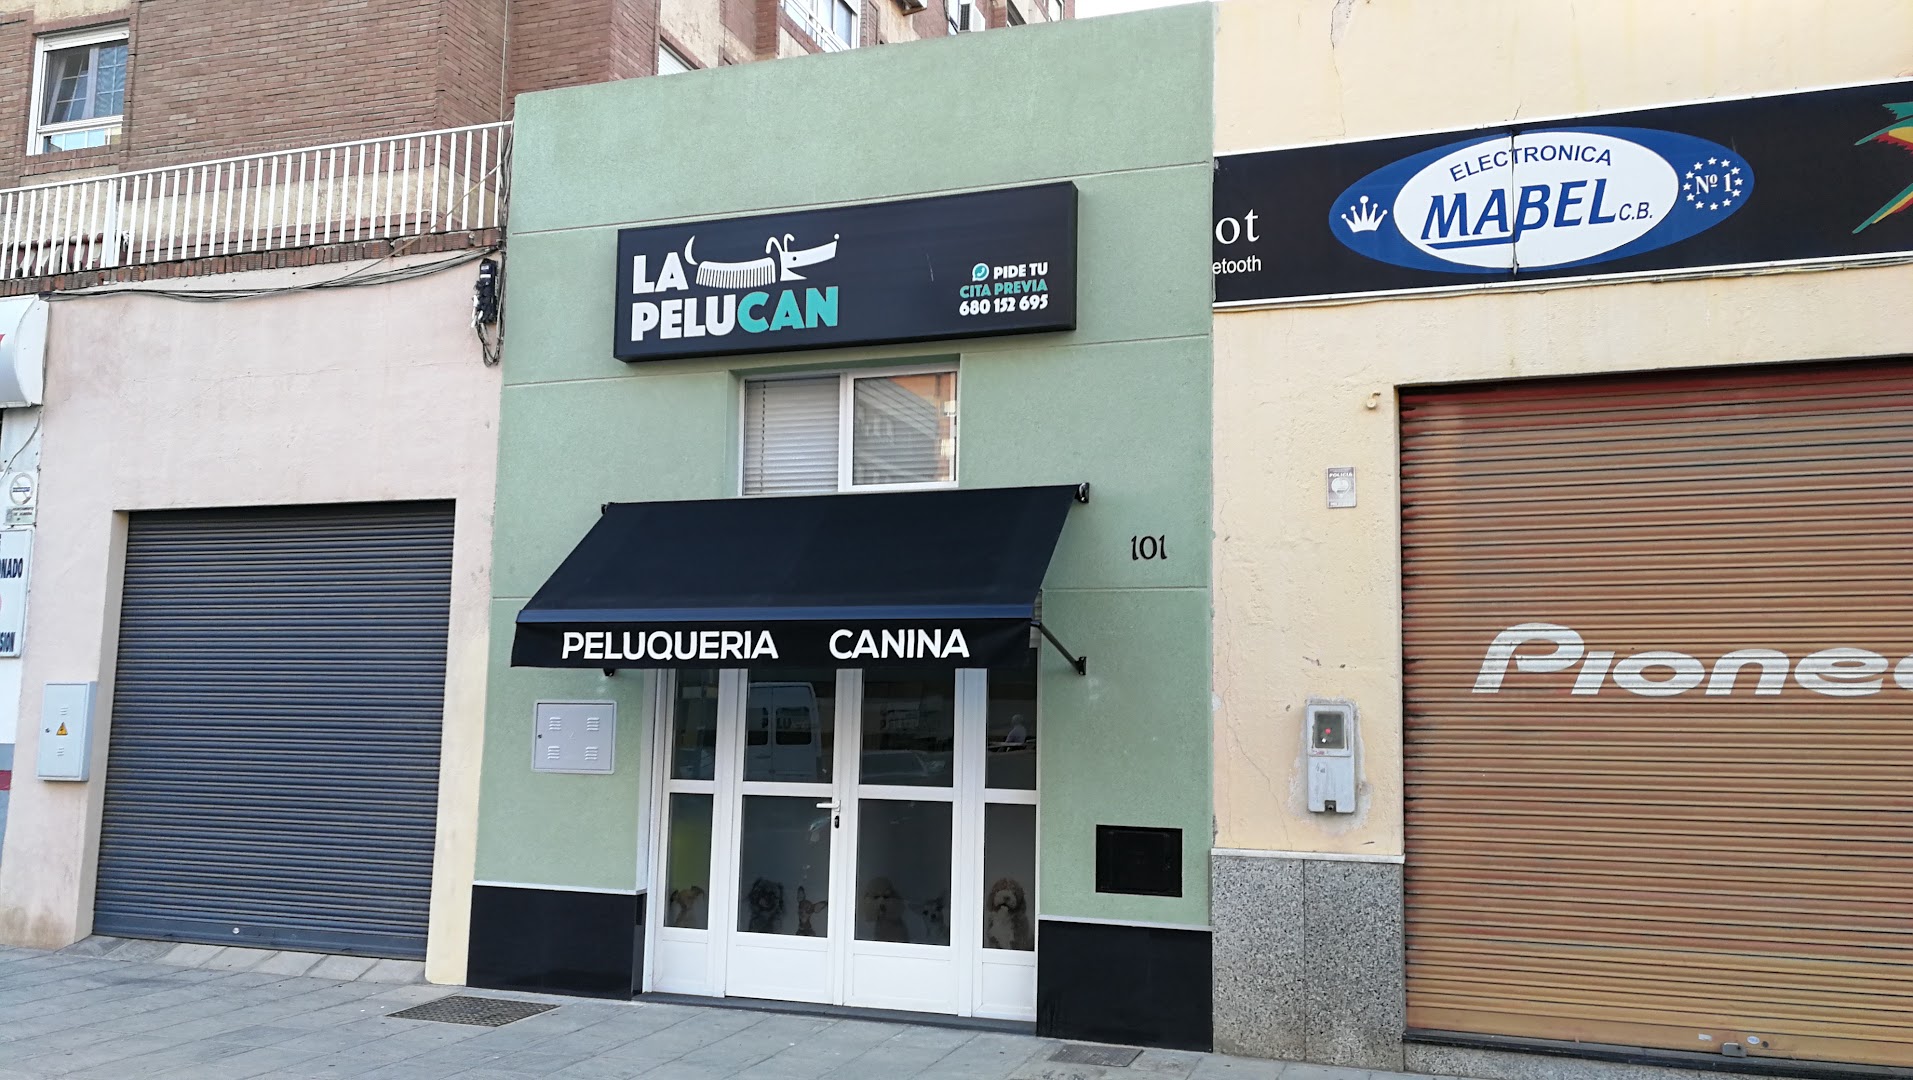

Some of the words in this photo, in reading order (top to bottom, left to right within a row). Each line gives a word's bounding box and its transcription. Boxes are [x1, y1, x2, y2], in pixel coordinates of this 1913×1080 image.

[1449, 144, 1612, 182] ELECTRONICA
[1723, 172, 1733, 192] 1
[1215, 208, 1260, 245] ot
[1420, 178, 1617, 243] MABEL
[1618, 201, 1653, 222] C.B.
[632, 251, 690, 295] LA
[993, 263, 1027, 280] PIDE
[1029, 261, 1048, 277] TU
[1212, 254, 1262, 275] etooth
[958, 298, 991, 317] 680
[993, 296, 1017, 314] 152
[1018, 293, 1049, 312] 695
[959, 283, 992, 299] CITA
[994, 278, 1049, 296] PREVIA
[630, 286, 839, 342] PELUCAN
[1130, 534, 1168, 561] 101
[561, 630, 780, 661] PELUQUERIA
[828, 628, 971, 660] CANINA
[1471, 622, 1913, 697] Pione
